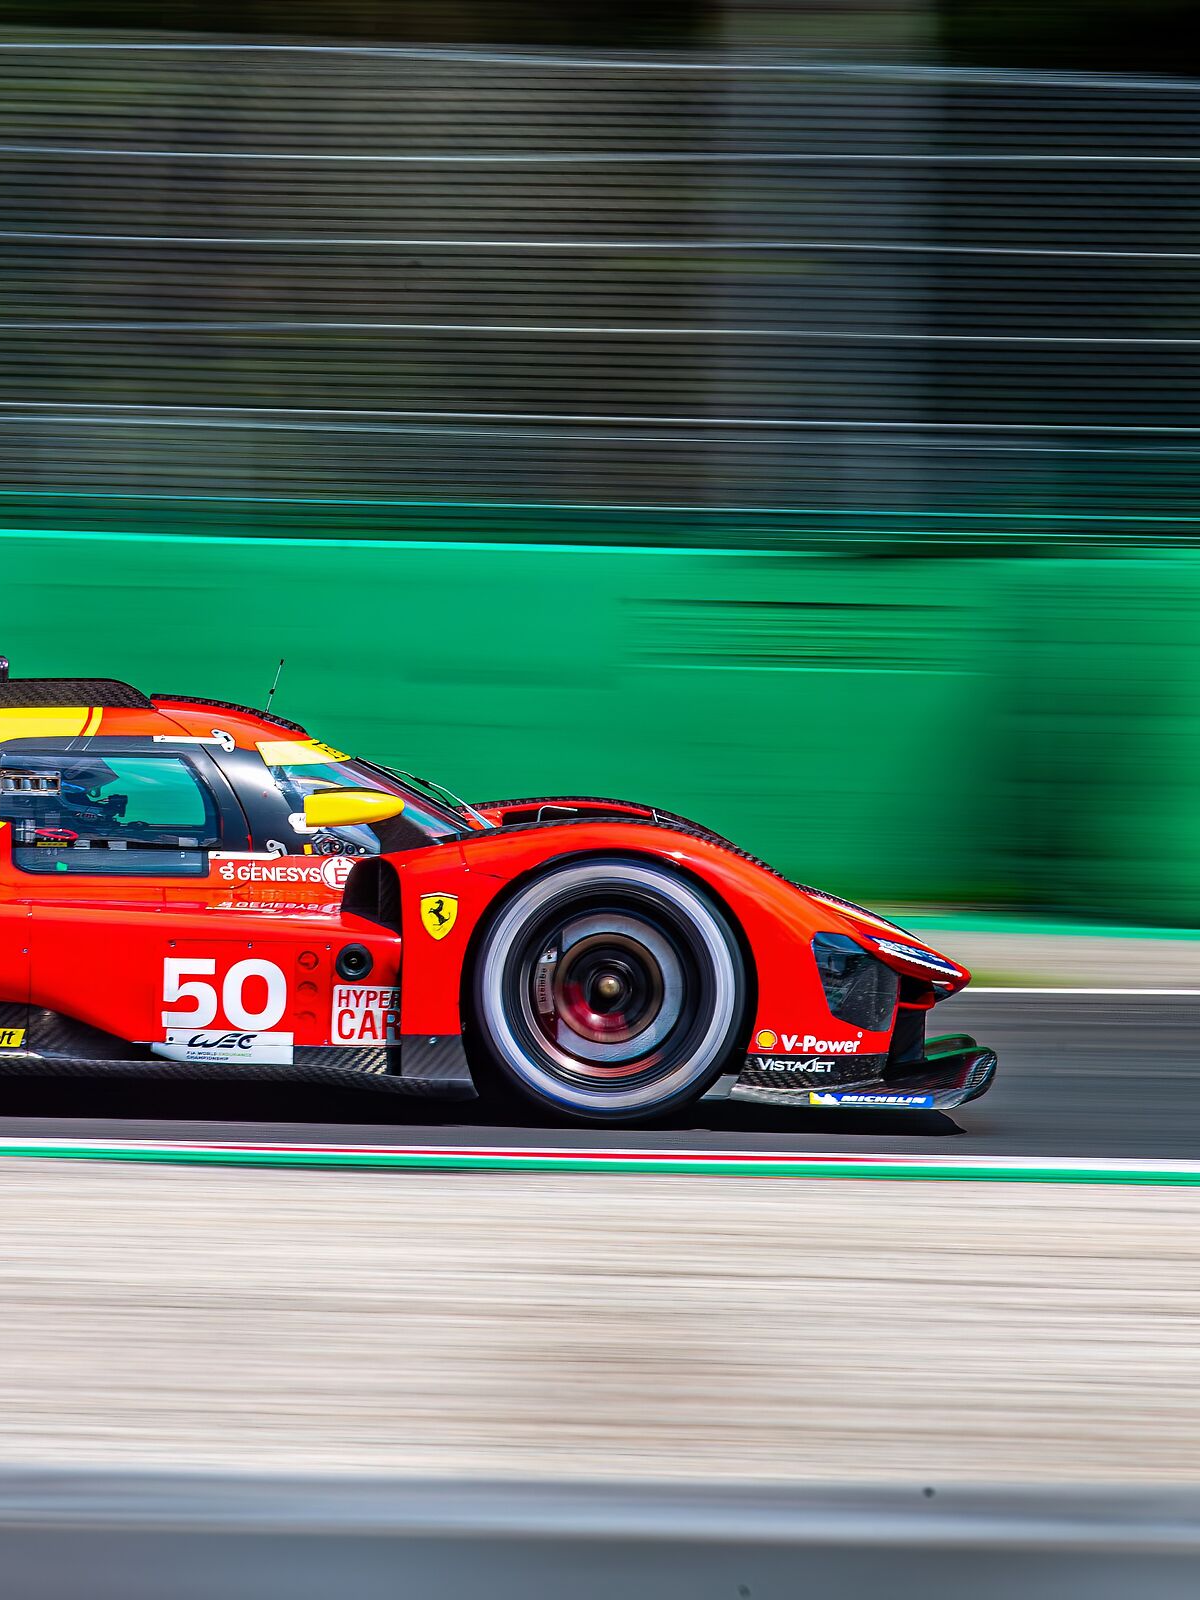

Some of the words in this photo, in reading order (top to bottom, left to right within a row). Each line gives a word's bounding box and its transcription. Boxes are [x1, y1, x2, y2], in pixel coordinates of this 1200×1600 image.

[237, 865, 322, 882] GENESYS
[161, 957, 287, 1031] 50
[337, 1009, 400, 1040] CAR
[187, 1033, 258, 1050] WEC
[780, 1034, 861, 1053] V-Power
[840, 1095, 927, 1104] MICHELIN
